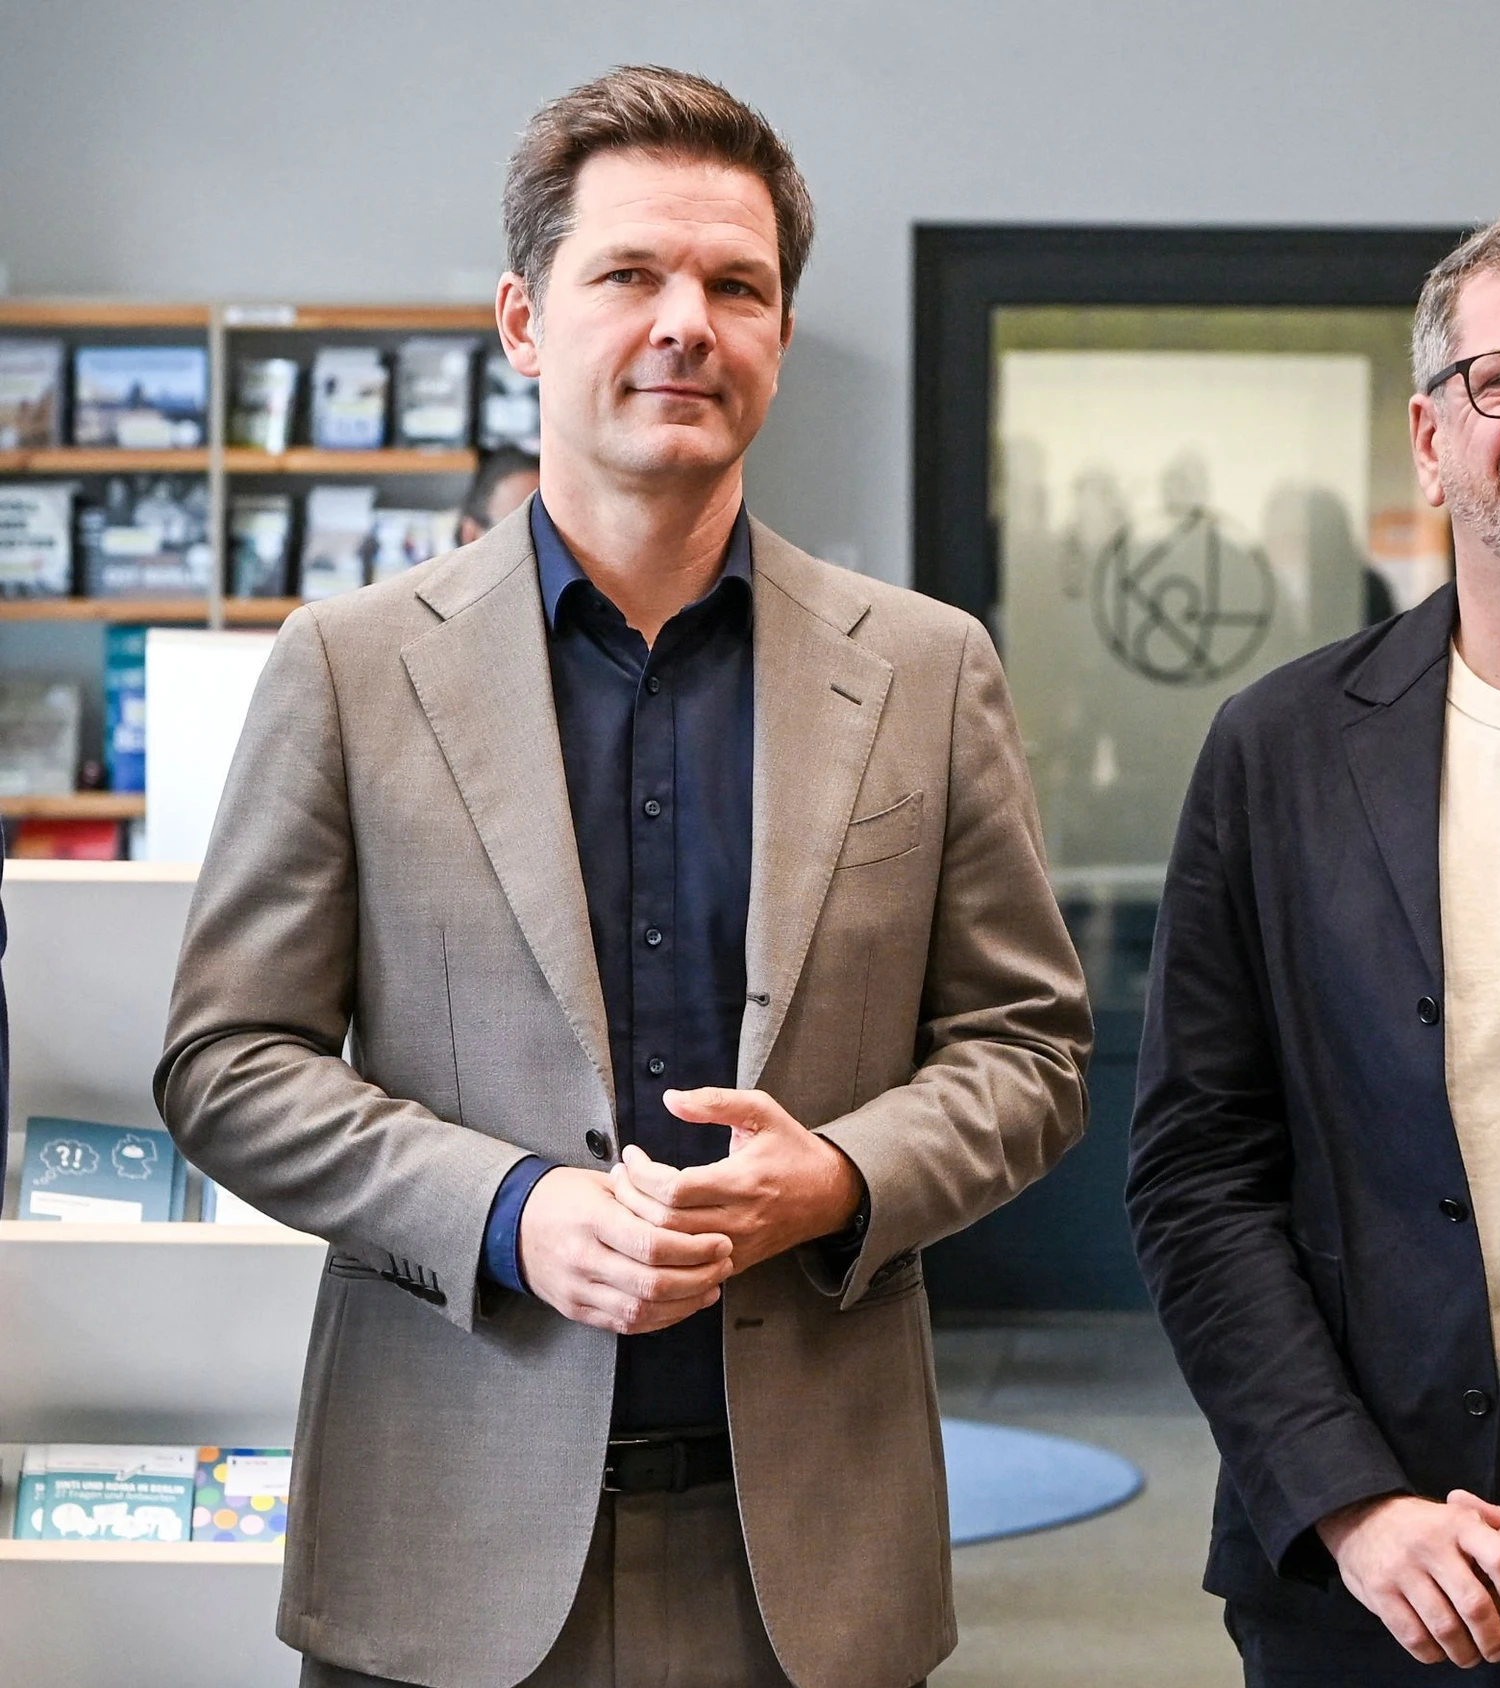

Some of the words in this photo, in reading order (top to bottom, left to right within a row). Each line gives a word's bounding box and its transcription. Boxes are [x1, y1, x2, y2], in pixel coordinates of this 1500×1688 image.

[55, 1480, 81, 1490] SINTI
[82, 1481, 104, 1491] UND
[105, 1482, 136, 1492] ROMA
[150, 1484, 186, 1495] BERLIN
